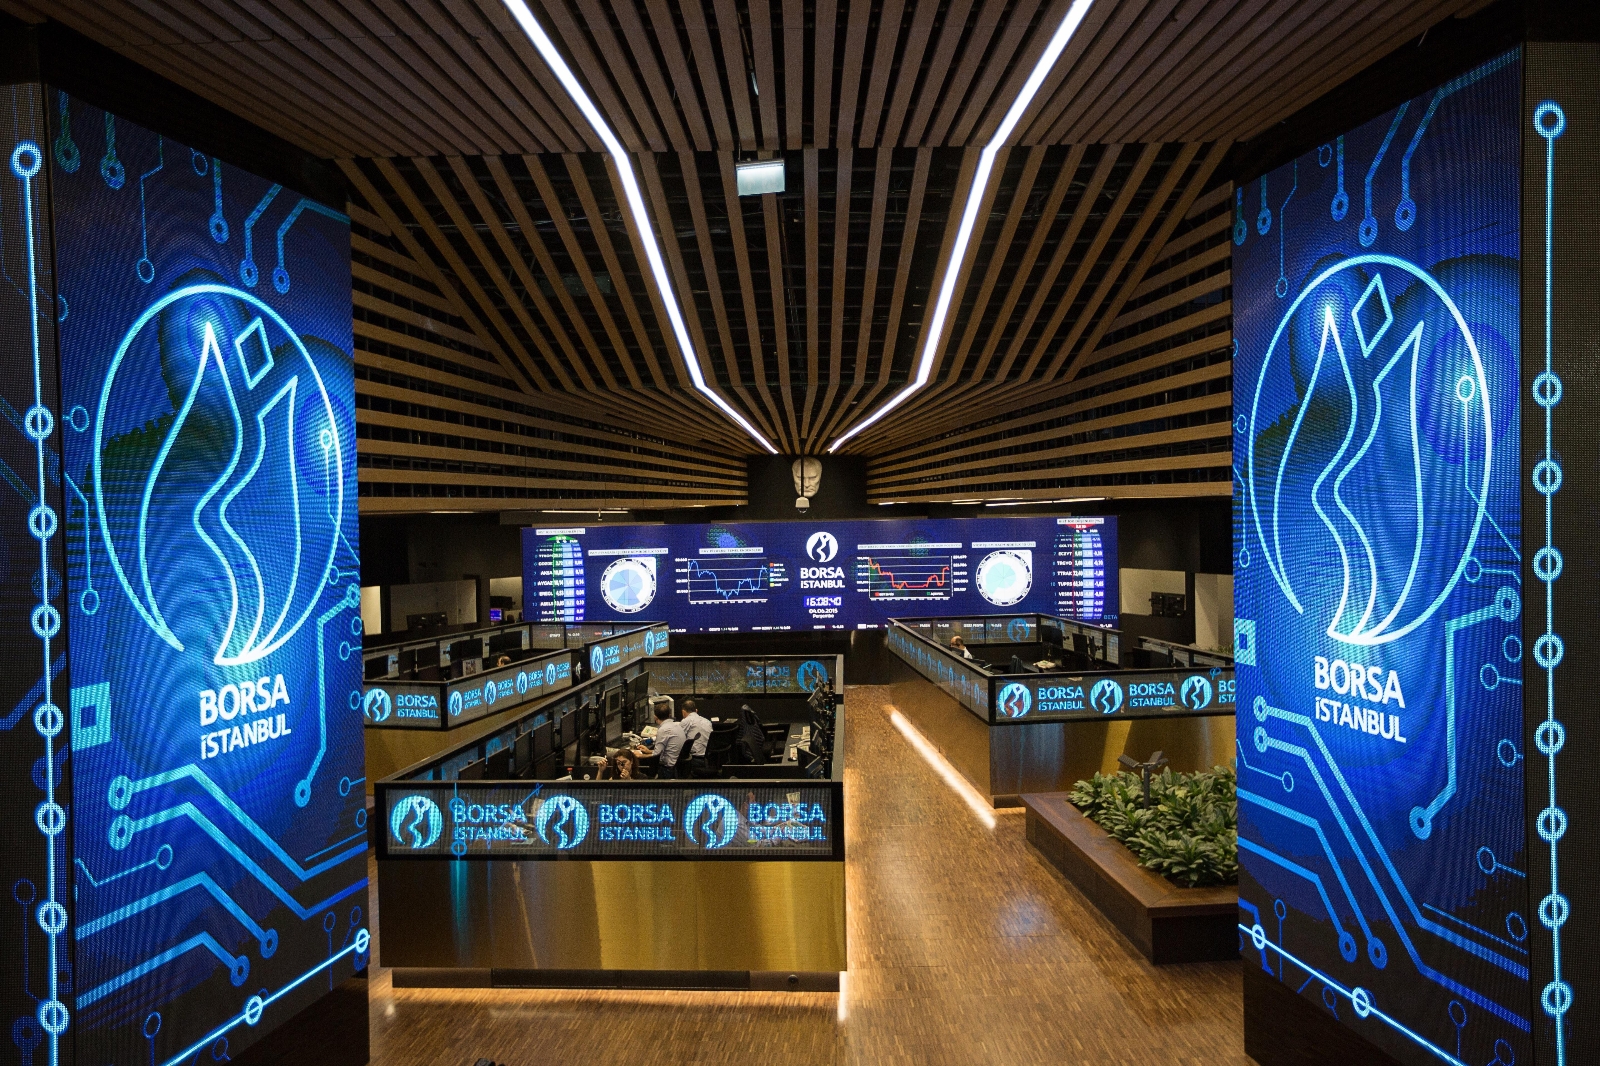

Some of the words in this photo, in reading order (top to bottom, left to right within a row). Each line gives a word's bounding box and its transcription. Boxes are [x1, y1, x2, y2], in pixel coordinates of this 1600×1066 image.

[800, 566, 845, 579] BORSA
[806, 596, 842, 606] 16:08:40
[498, 678, 514, 690] BORSA
[1129, 682, 1175, 697] BORSA
[1314, 656, 1406, 710] BORSA
[200, 673, 290, 726] BORSA
[464, 688, 482, 701] BORSA
[1038, 686, 1085, 700] BORSA
[396, 694, 438, 708] BORSA
[1314, 698, 1407, 744] İSTANBUL
[200, 713, 292, 760] İSTANBUL
[452, 804, 528, 824] BORSA
[599, 803, 676, 824] BORSA
[749, 802, 826, 824] BORSA
